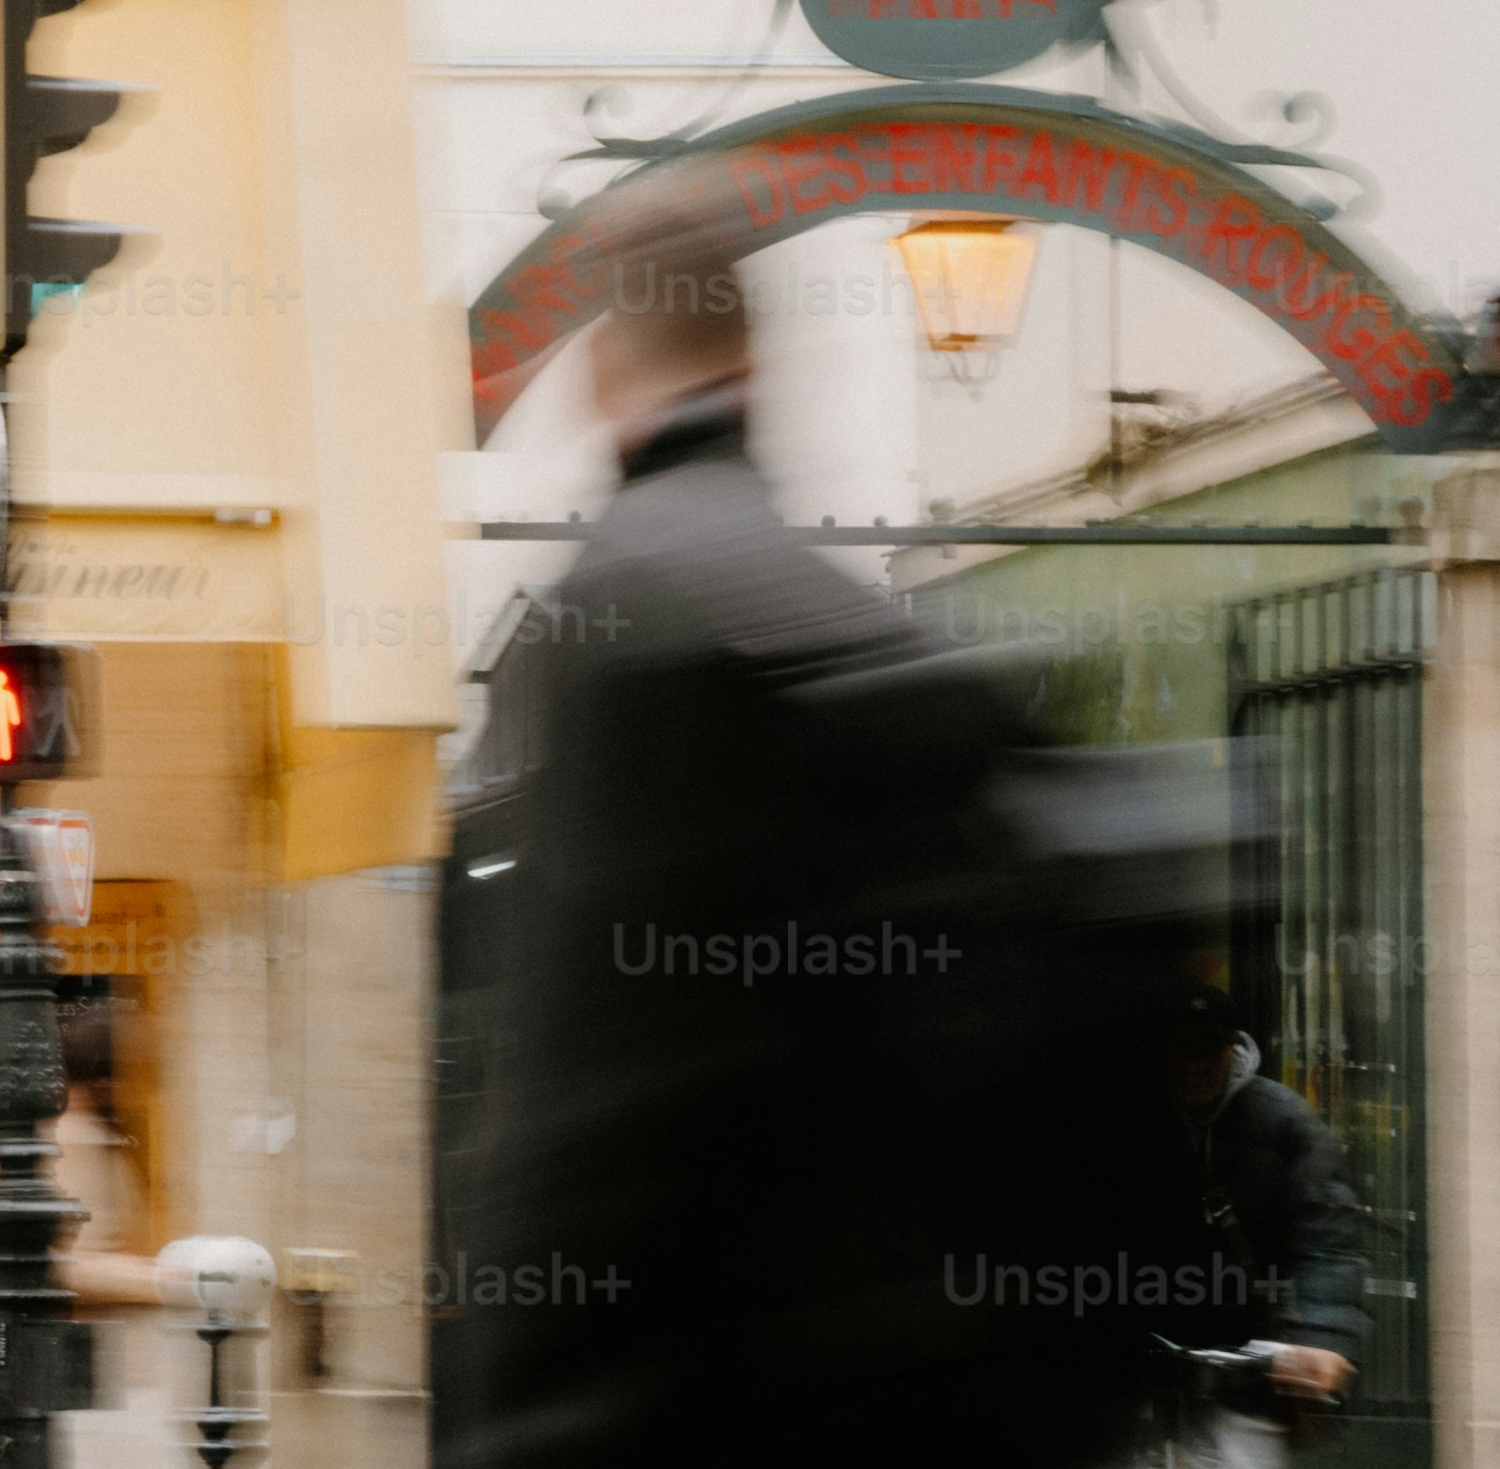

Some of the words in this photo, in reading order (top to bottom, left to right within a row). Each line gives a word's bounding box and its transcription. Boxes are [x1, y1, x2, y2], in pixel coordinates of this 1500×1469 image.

[730, 132, 878, 232] DES
[885, 122, 1205, 237] ENFANTS
[1198, 190, 1455, 429] ROUGES
